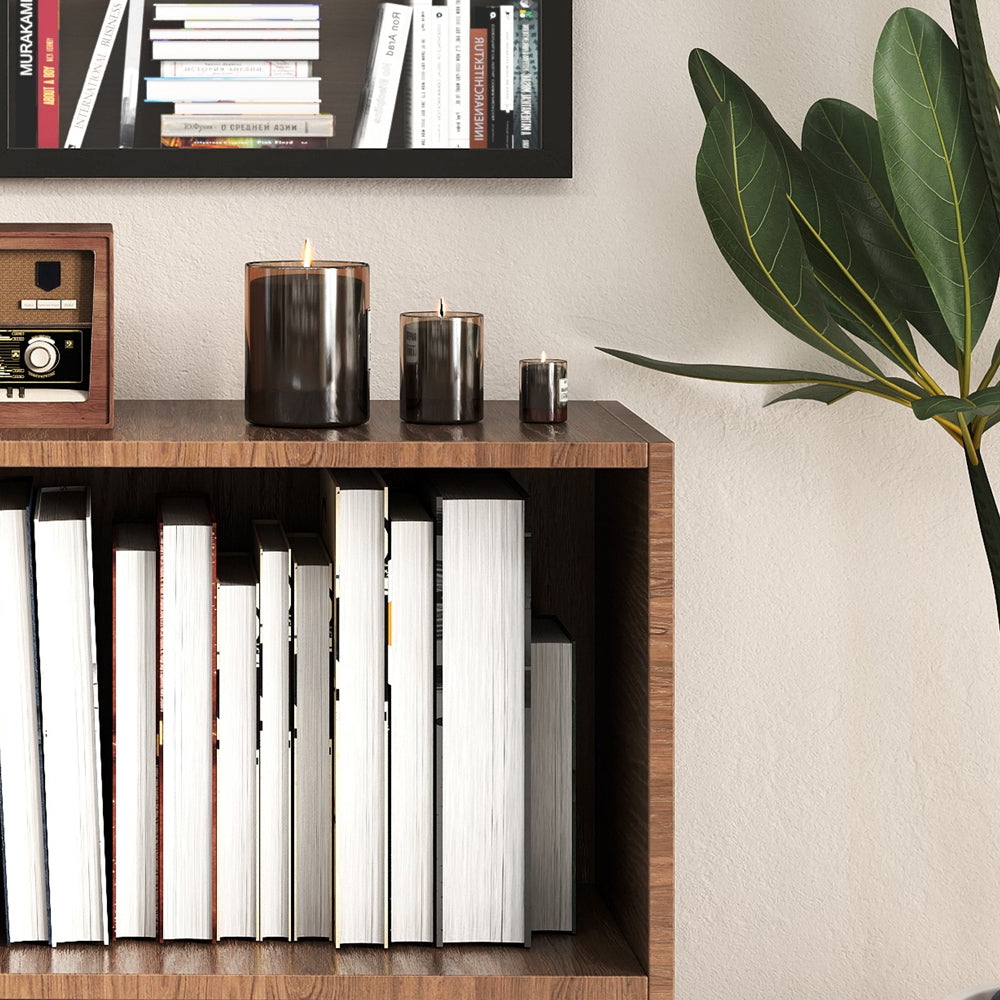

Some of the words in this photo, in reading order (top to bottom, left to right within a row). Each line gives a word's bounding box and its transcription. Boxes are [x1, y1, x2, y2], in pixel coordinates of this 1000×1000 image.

[20, 0, 33, 76] MURAKAMI
[43, 66, 55, 78] BOY
[74, 53, 106, 129] INTERNATIONAL
[100, 1, 122, 47] BUSINESS
[43, 87, 55, 105] ABOUT
[230, 123, 270, 131] СРЕДНЕЙ
